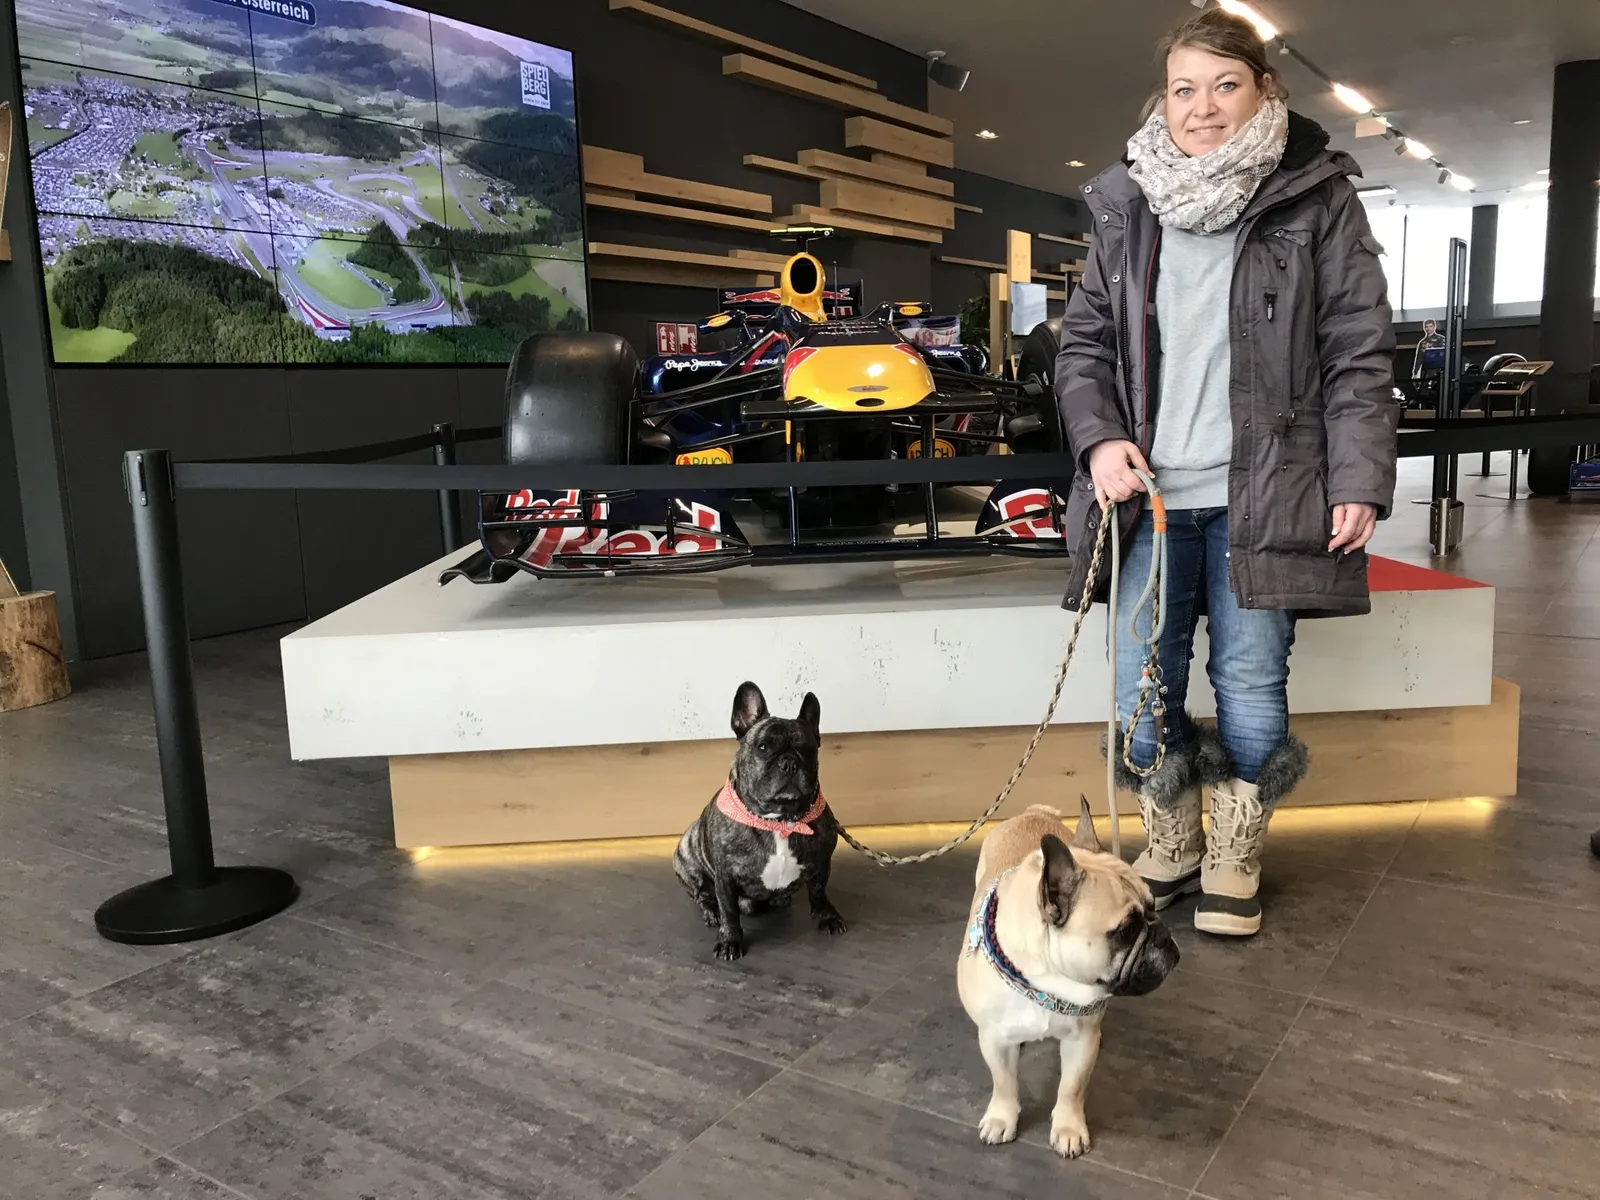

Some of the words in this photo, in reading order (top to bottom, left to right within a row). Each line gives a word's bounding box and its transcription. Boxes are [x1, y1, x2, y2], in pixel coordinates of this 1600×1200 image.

[522, 65, 548, 81] SPIEL
[523, 78, 548, 95] BERG
[664, 359, 691, 372] Pepe
